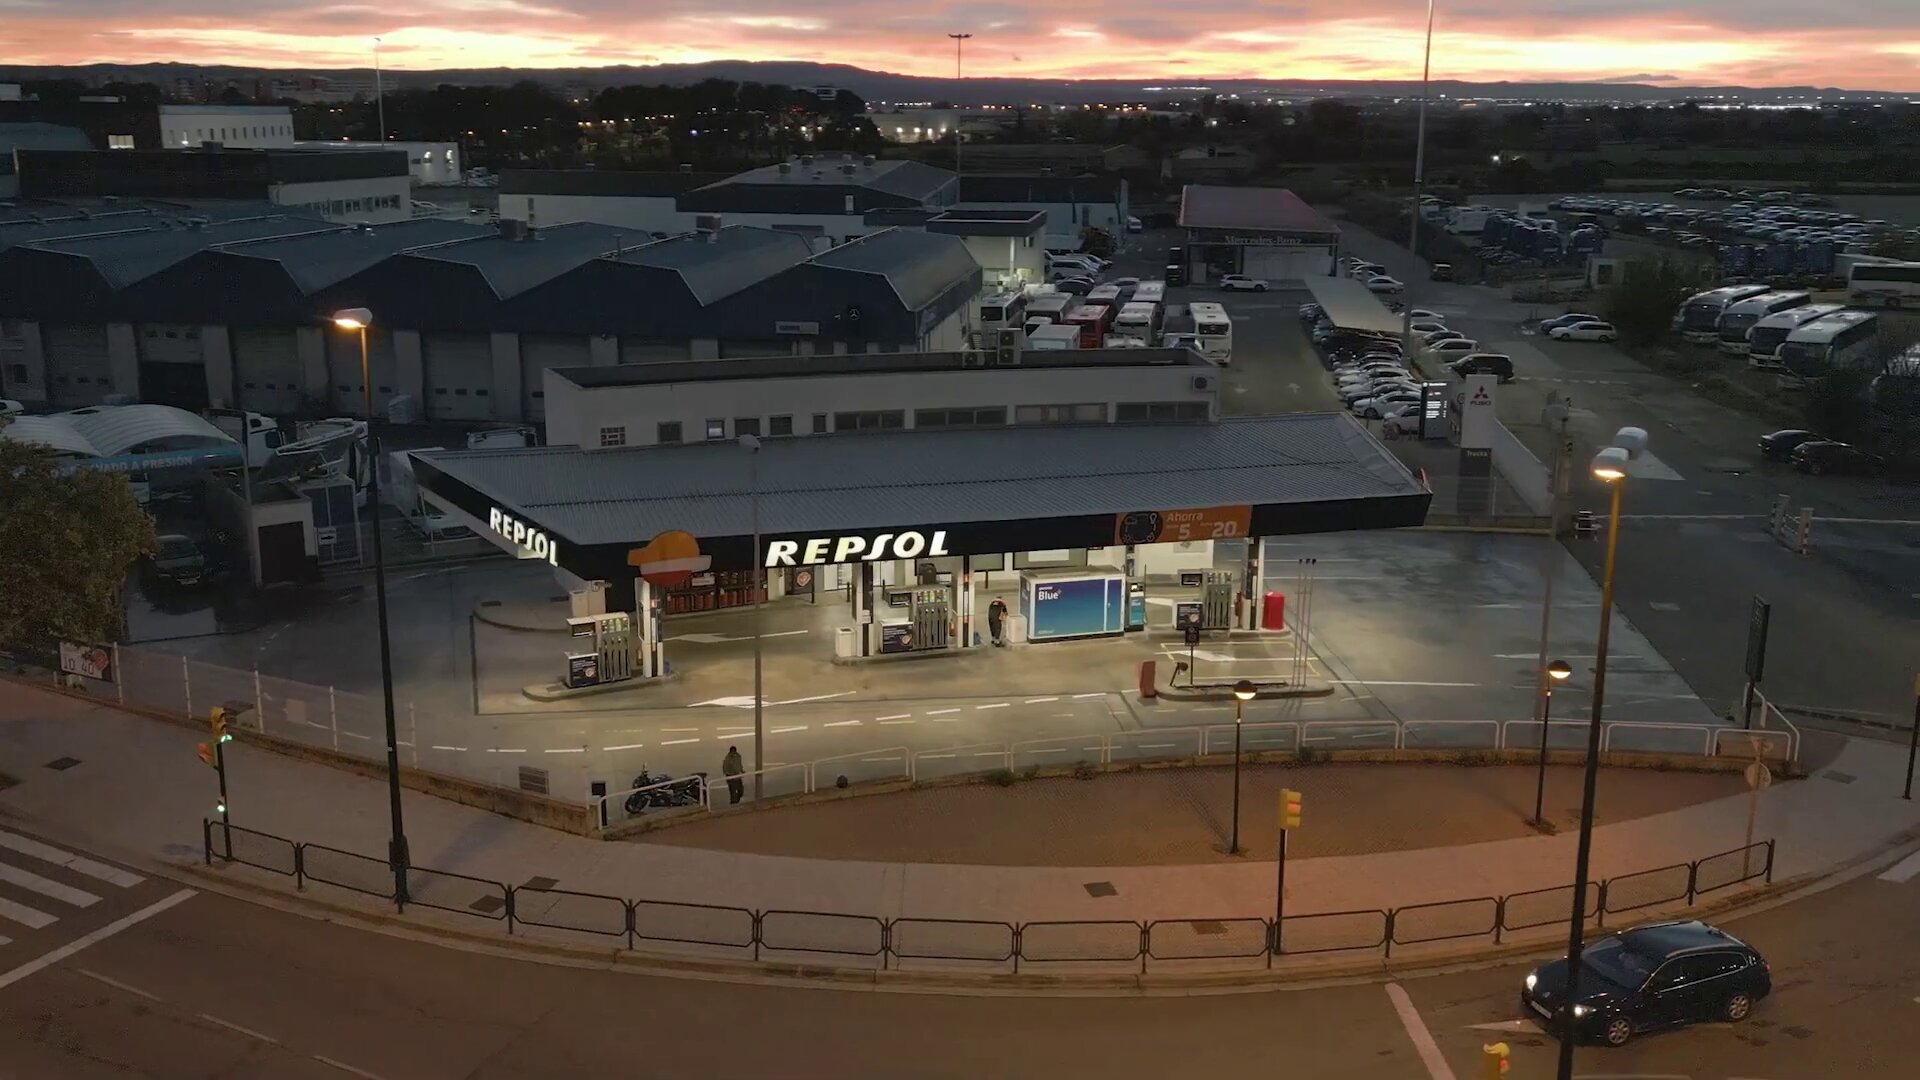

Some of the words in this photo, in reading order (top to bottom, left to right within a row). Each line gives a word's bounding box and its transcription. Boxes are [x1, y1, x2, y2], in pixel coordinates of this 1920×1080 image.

[1225, 235, 1303, 246] Mercedes-Benz
[131, 460, 140, 471] A
[142, 455, 193, 470] PRESIÓN
[1166, 511, 1204, 522] Ahorra
[490, 506, 558, 567] REPSOL
[1178, 523, 1191, 540] 5
[1212, 521, 1238, 538] 20
[765, 531, 948, 568] REPSOL
